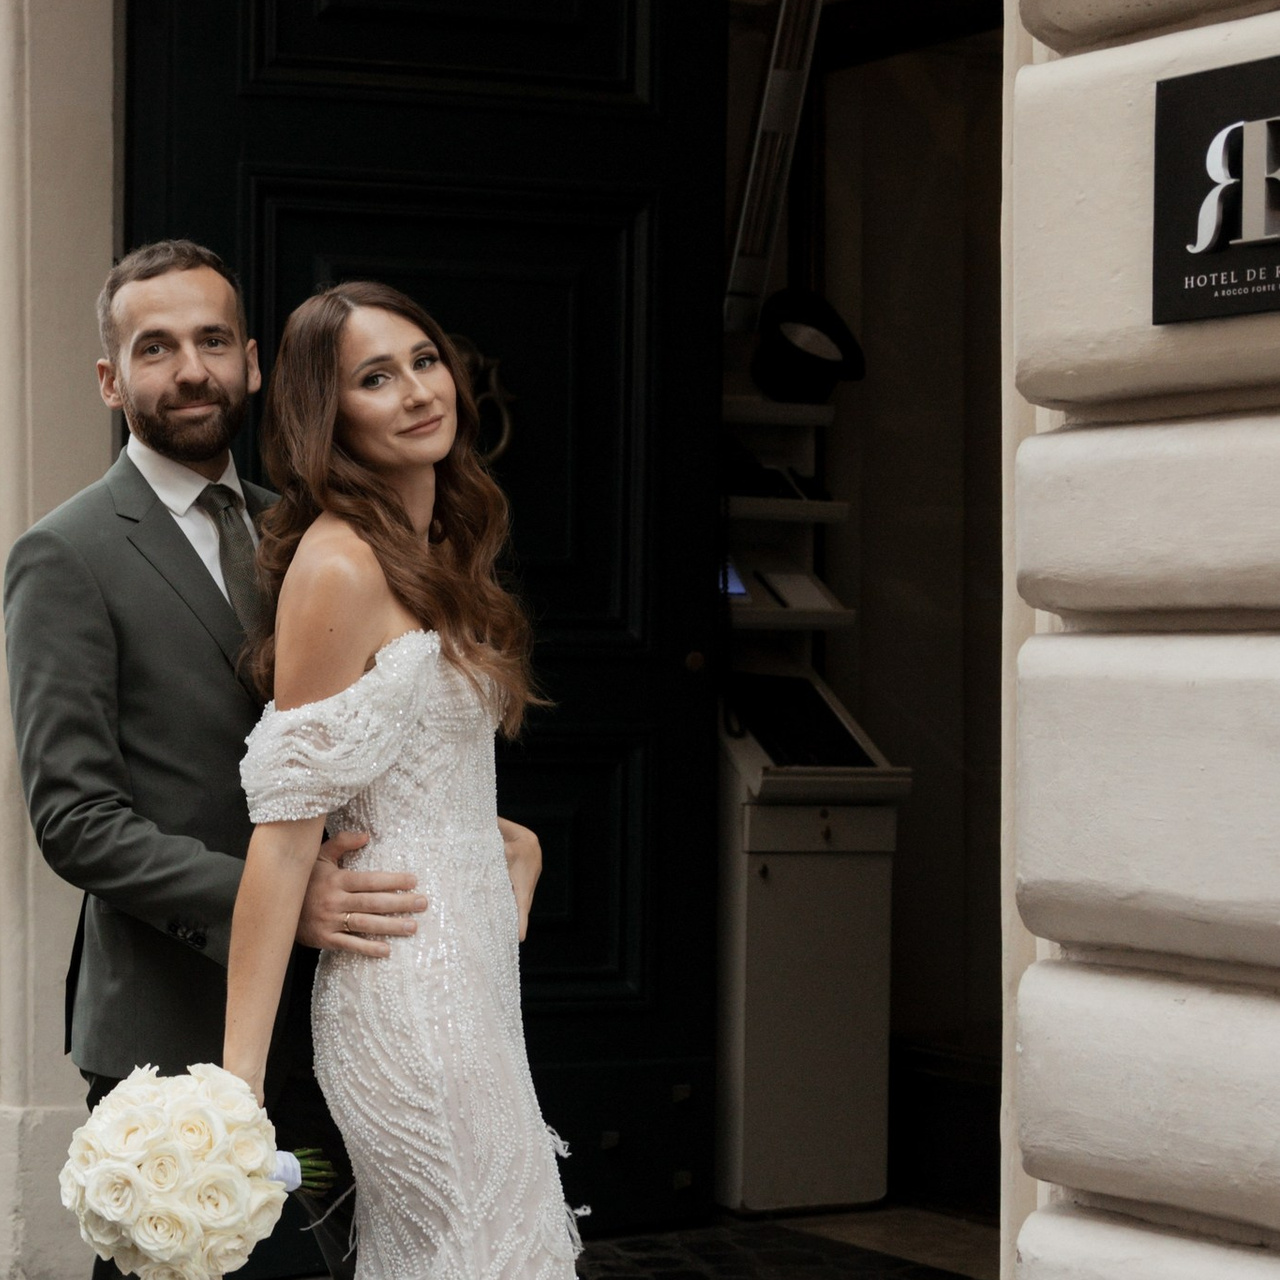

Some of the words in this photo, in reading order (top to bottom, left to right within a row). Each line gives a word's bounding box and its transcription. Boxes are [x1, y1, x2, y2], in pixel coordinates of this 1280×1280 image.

[1184, 271, 1238, 289] HOTEL
[1246, 267, 1267, 282] DE
[1221, 287, 1249, 296] ROCCO
[1251, 284, 1276, 293] FORTE
